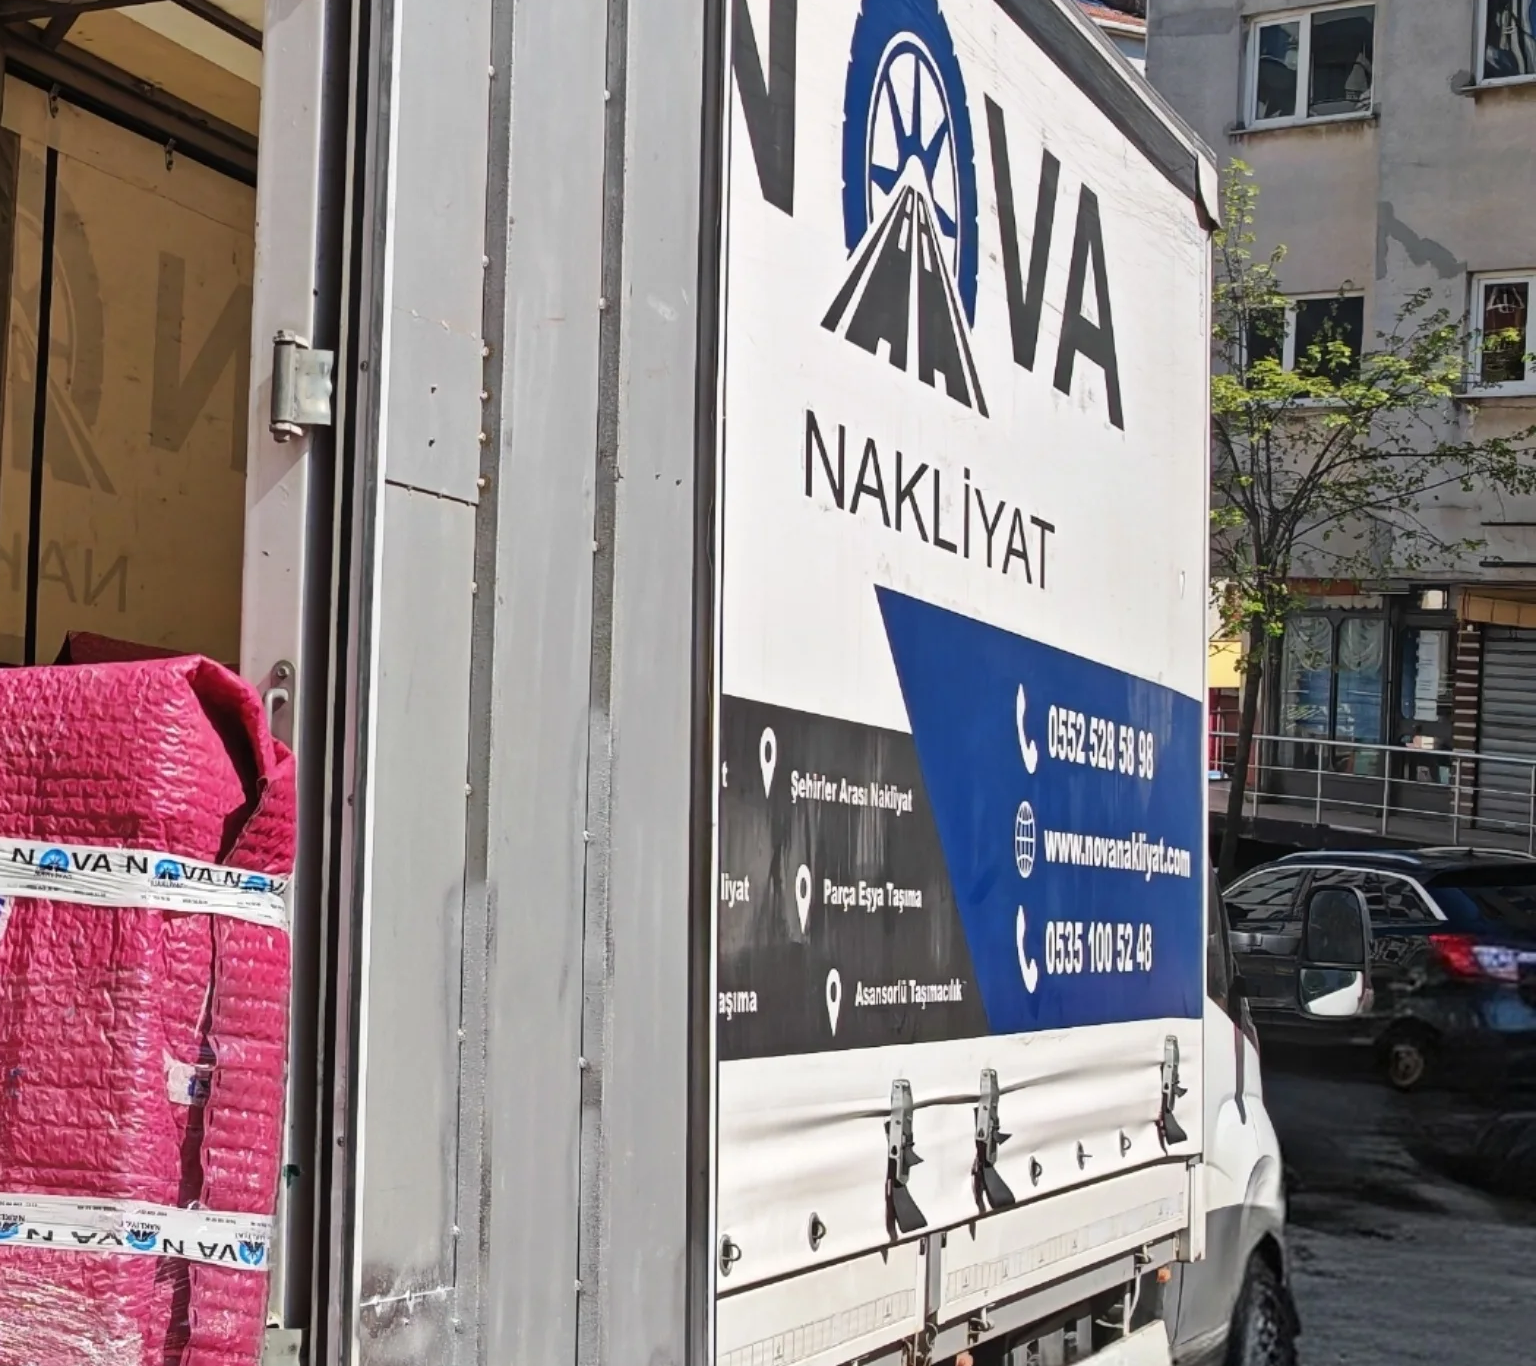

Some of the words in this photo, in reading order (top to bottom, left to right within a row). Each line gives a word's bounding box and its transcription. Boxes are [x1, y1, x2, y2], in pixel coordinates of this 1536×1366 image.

[806, 410, 1055, 589] NAKLİYAT
[1048, 704, 1086, 764] 0552
[1089, 717, 1115, 771] 528
[1119, 724, 1134, 776] 58
[1138, 730, 1154, 780] 98
[791, 770, 836, 803] Şehirler
[840, 778, 868, 805] Arası
[870, 783, 913, 817] Nakliyat
[12, 847, 112, 875] NOVA
[1044, 830, 1191, 881] www.novanakliyat.com
[824, 879, 856, 911] Parça
[859, 882, 884, 913] Eşya
[886, 882, 922, 913] Taşıma
[1045, 921, 1084, 975] 0535
[1088, 921, 1112, 974] 100
[1117, 923, 1133, 973] 52
[1136, 923, 1152, 973] 48
[909, 978, 962, 1009] Taşımacılık
